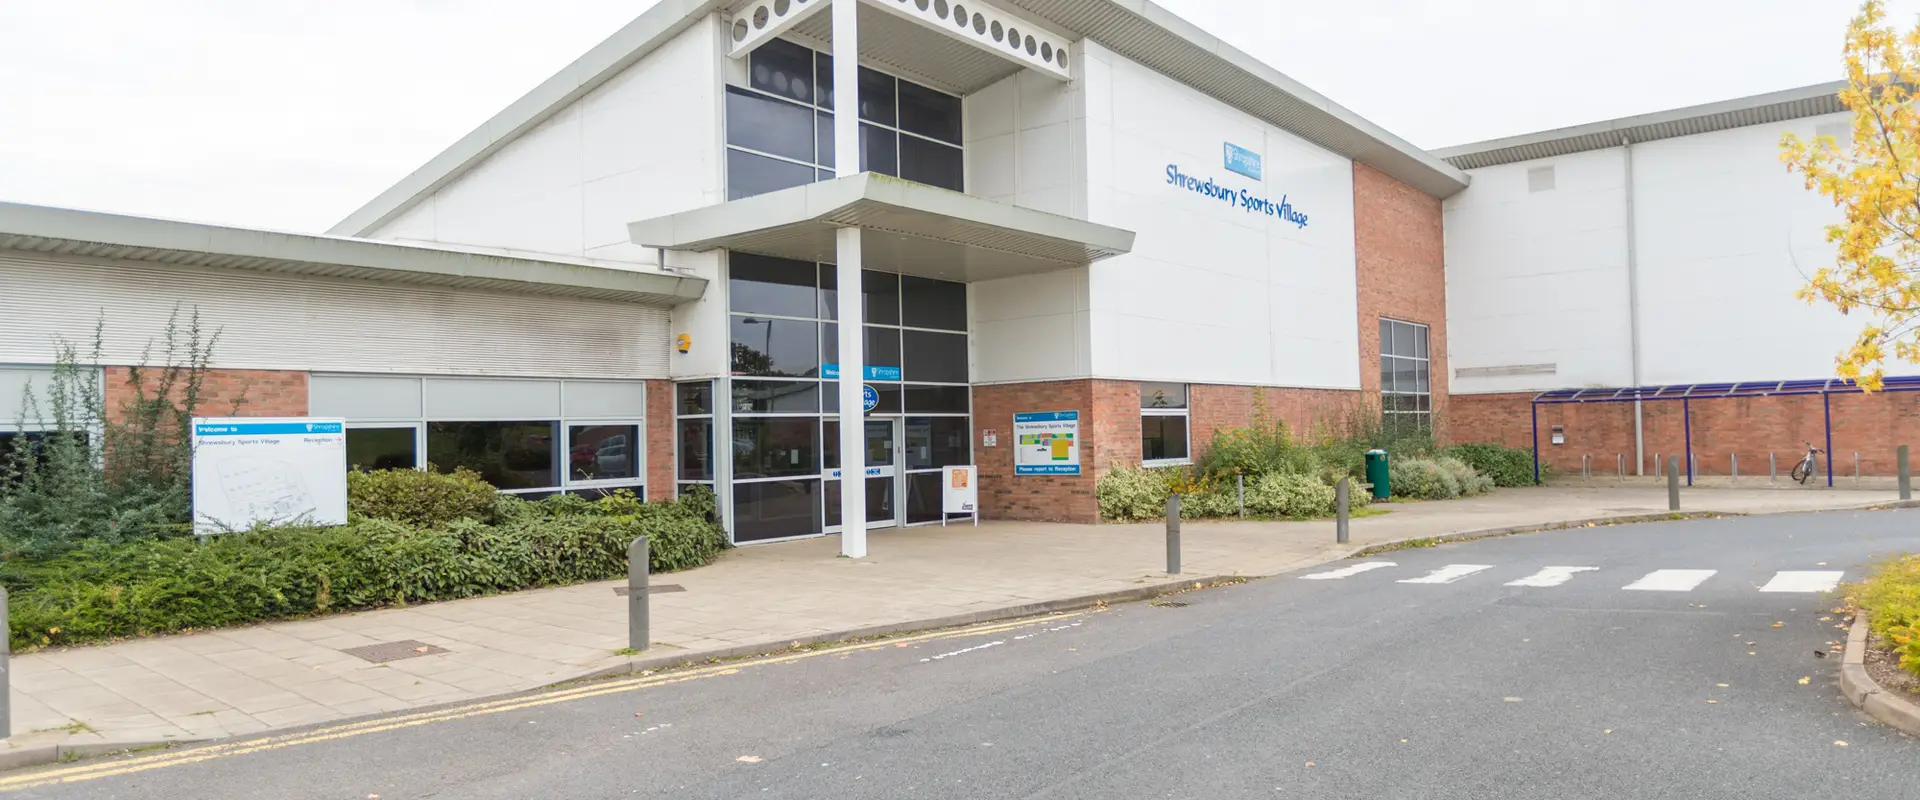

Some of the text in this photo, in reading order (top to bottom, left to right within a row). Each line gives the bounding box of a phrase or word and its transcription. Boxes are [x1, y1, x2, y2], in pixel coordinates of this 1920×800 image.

[1166, 164, 1308, 229] Shrewsbury Sports Village
